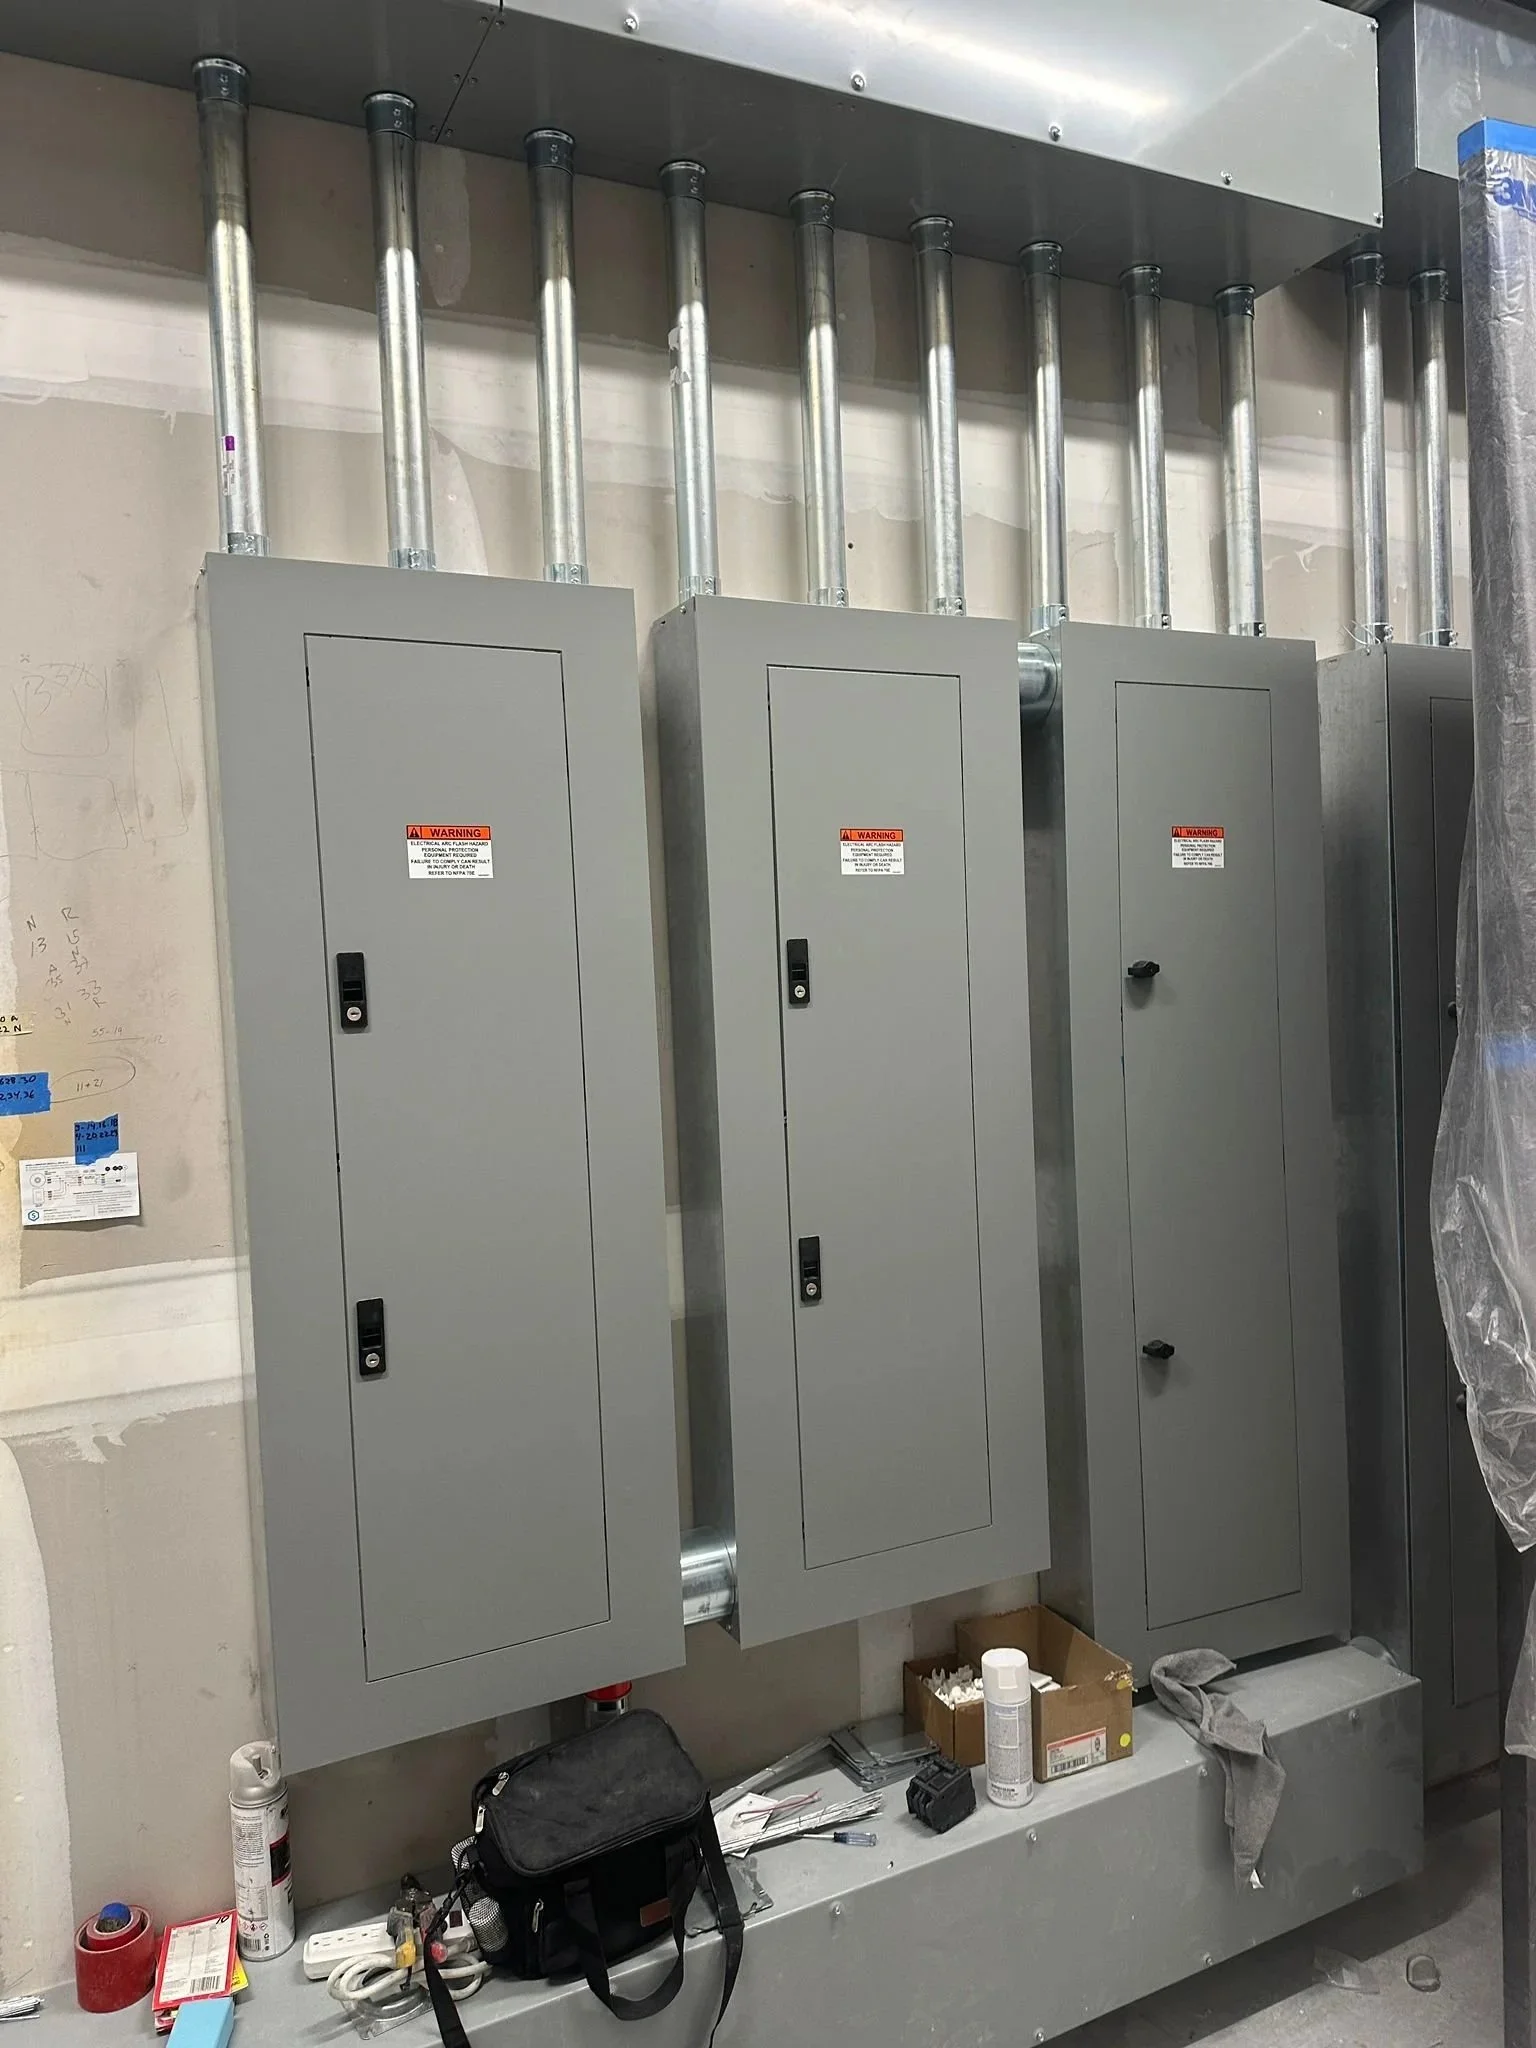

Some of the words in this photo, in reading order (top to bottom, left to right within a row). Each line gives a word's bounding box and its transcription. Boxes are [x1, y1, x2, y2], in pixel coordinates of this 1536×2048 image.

[430, 828, 481, 837] WARNING
[26, 914, 37, 931] N
[13, 1024, 21, 1032] N
[216, 1915, 229, 1925] 10
